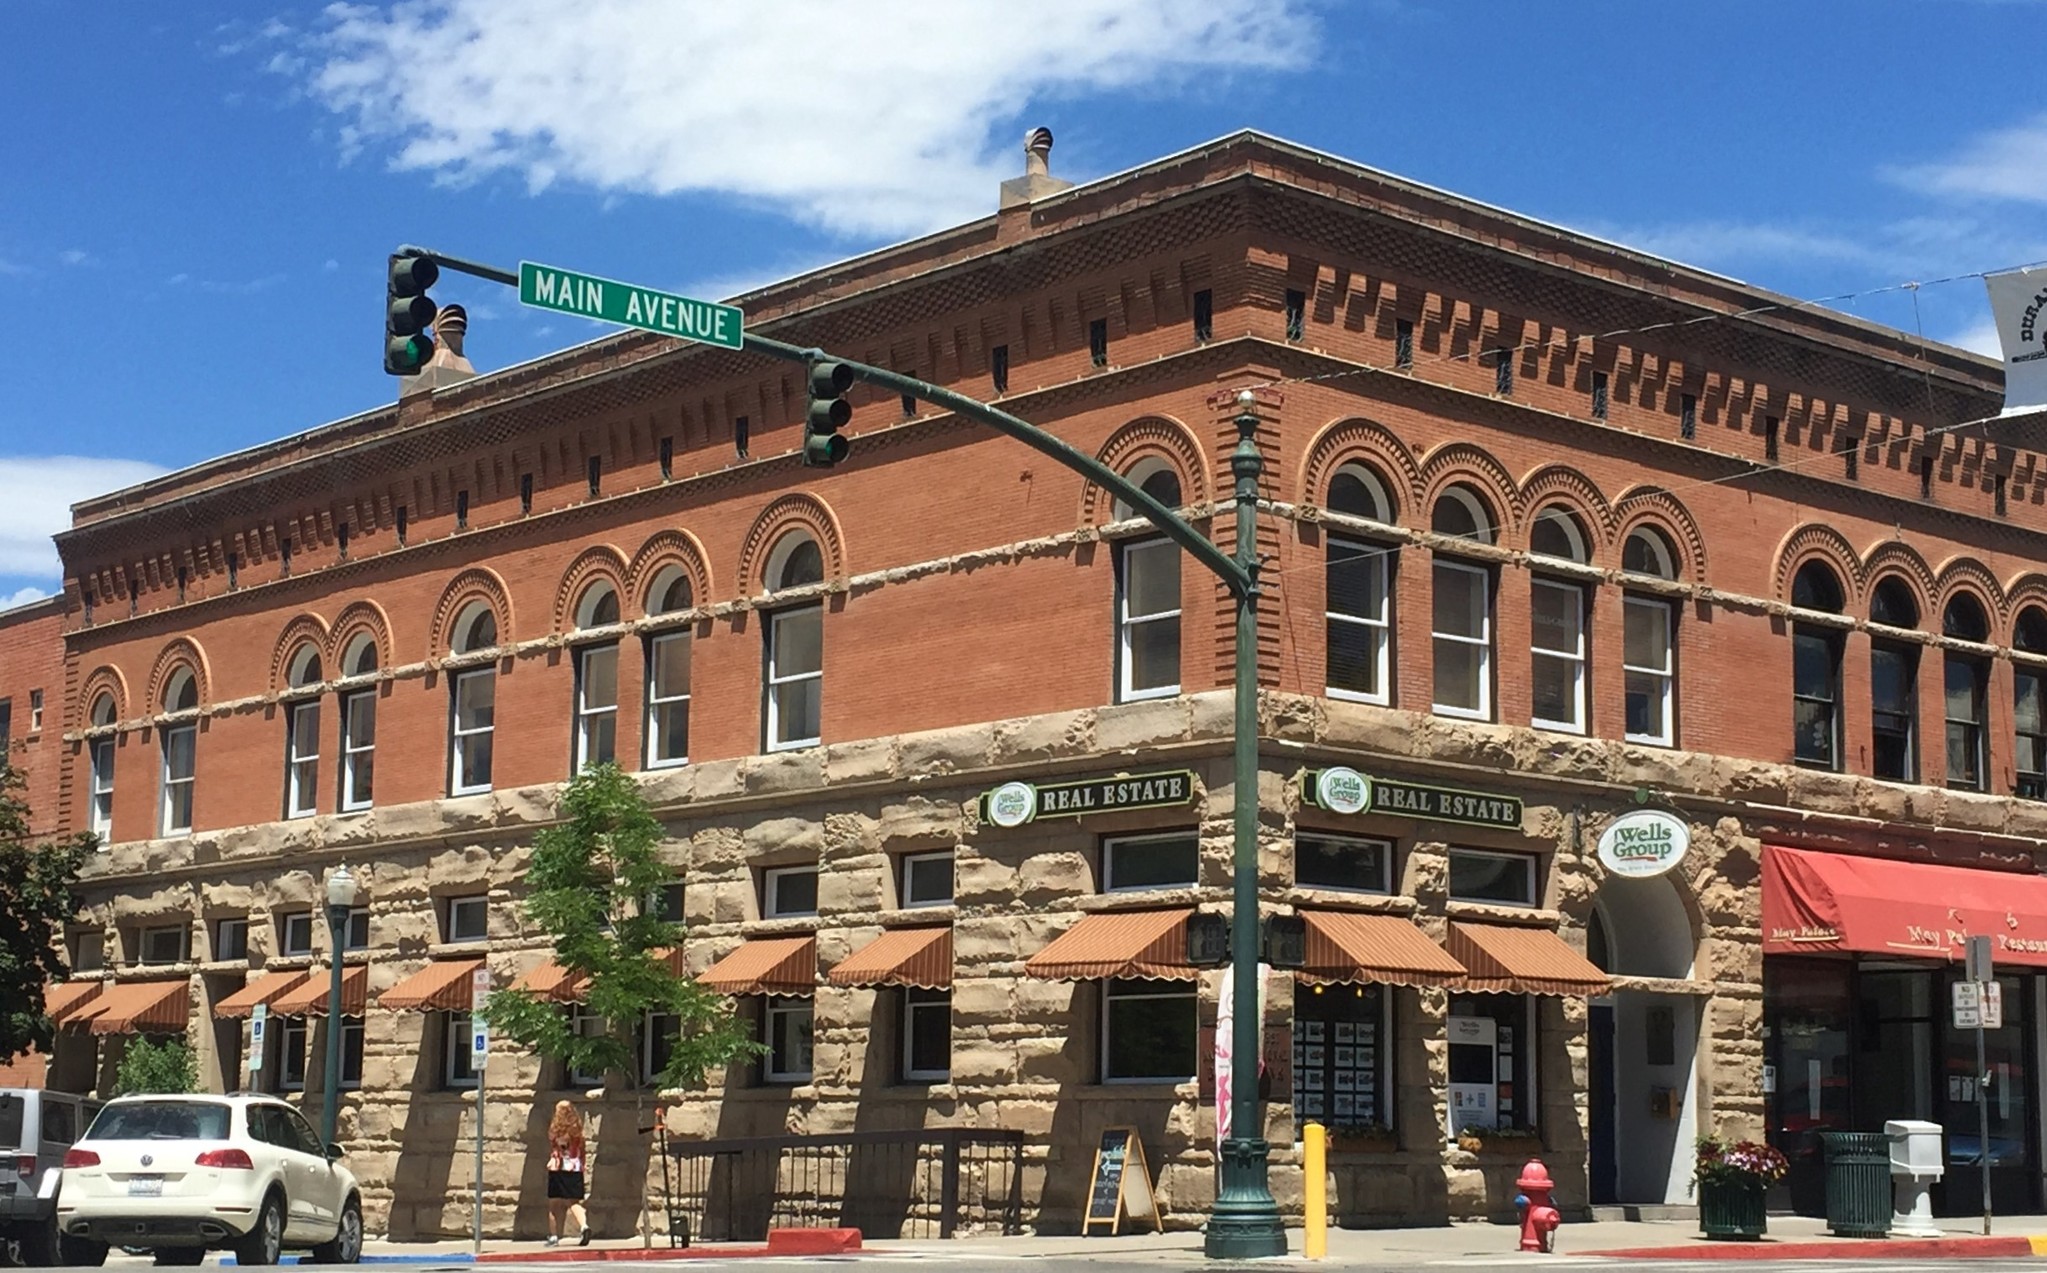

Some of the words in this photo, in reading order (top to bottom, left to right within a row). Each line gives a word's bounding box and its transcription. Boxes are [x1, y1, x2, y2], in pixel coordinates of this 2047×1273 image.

[535, 270, 603, 315] MAIN
[625, 290, 729, 342] AVENUE
[1043, 788, 1095, 812] REAL
[1103, 777, 1183, 805] ESTATE
[1330, 776, 1361, 791] Wells
[1329, 786, 1361, 804] Group
[1376, 786, 1432, 812] REAL
[1440, 794, 1515, 822] ESTATE
[1613, 822, 1672, 843] Wells
[1613, 842, 1672, 860] Group
[1907, 926, 1940, 949] May
